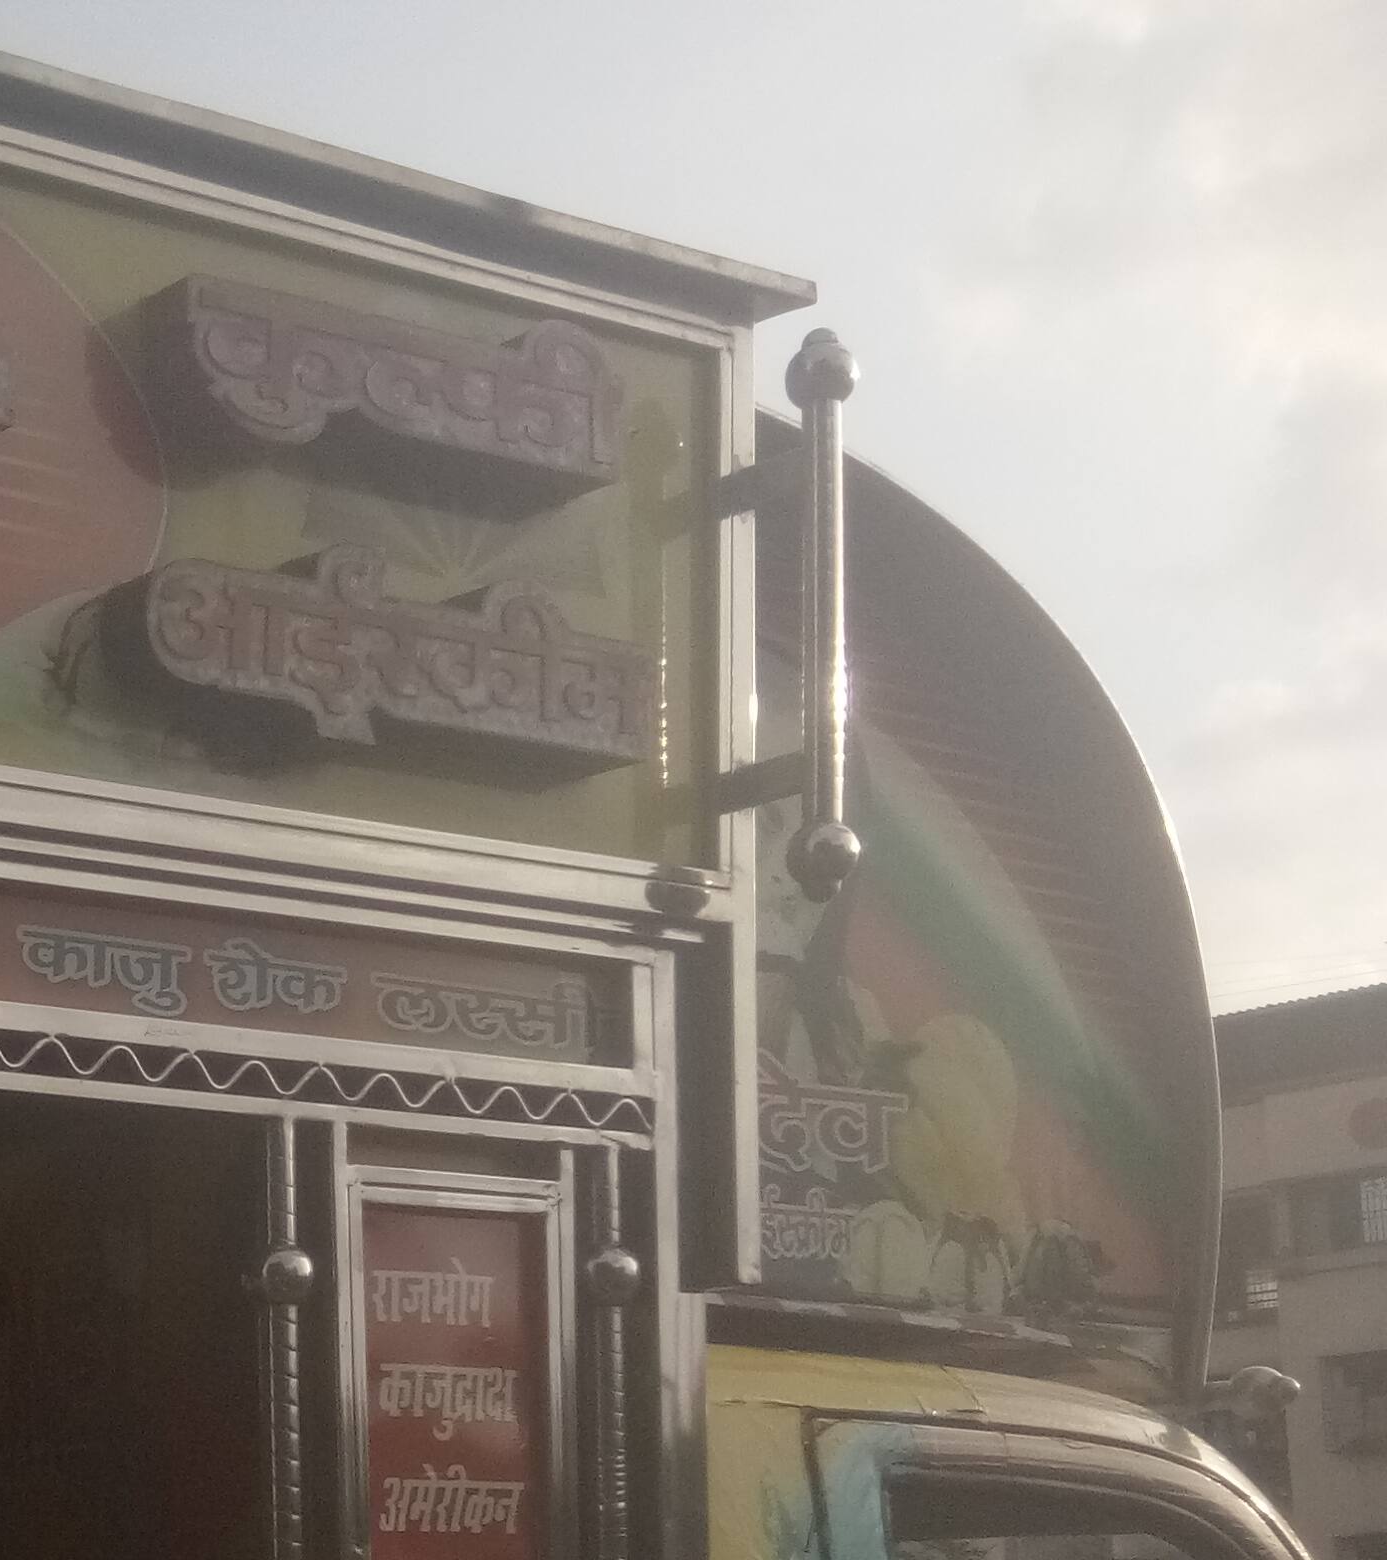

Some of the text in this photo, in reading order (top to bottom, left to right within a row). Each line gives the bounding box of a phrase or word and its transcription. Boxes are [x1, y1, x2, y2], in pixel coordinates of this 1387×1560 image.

[204, 938, 345, 1012] शेक
[371, 1257, 494, 1328] राजभोग
[380, 1464, 524, 1534] अमेरीकन
